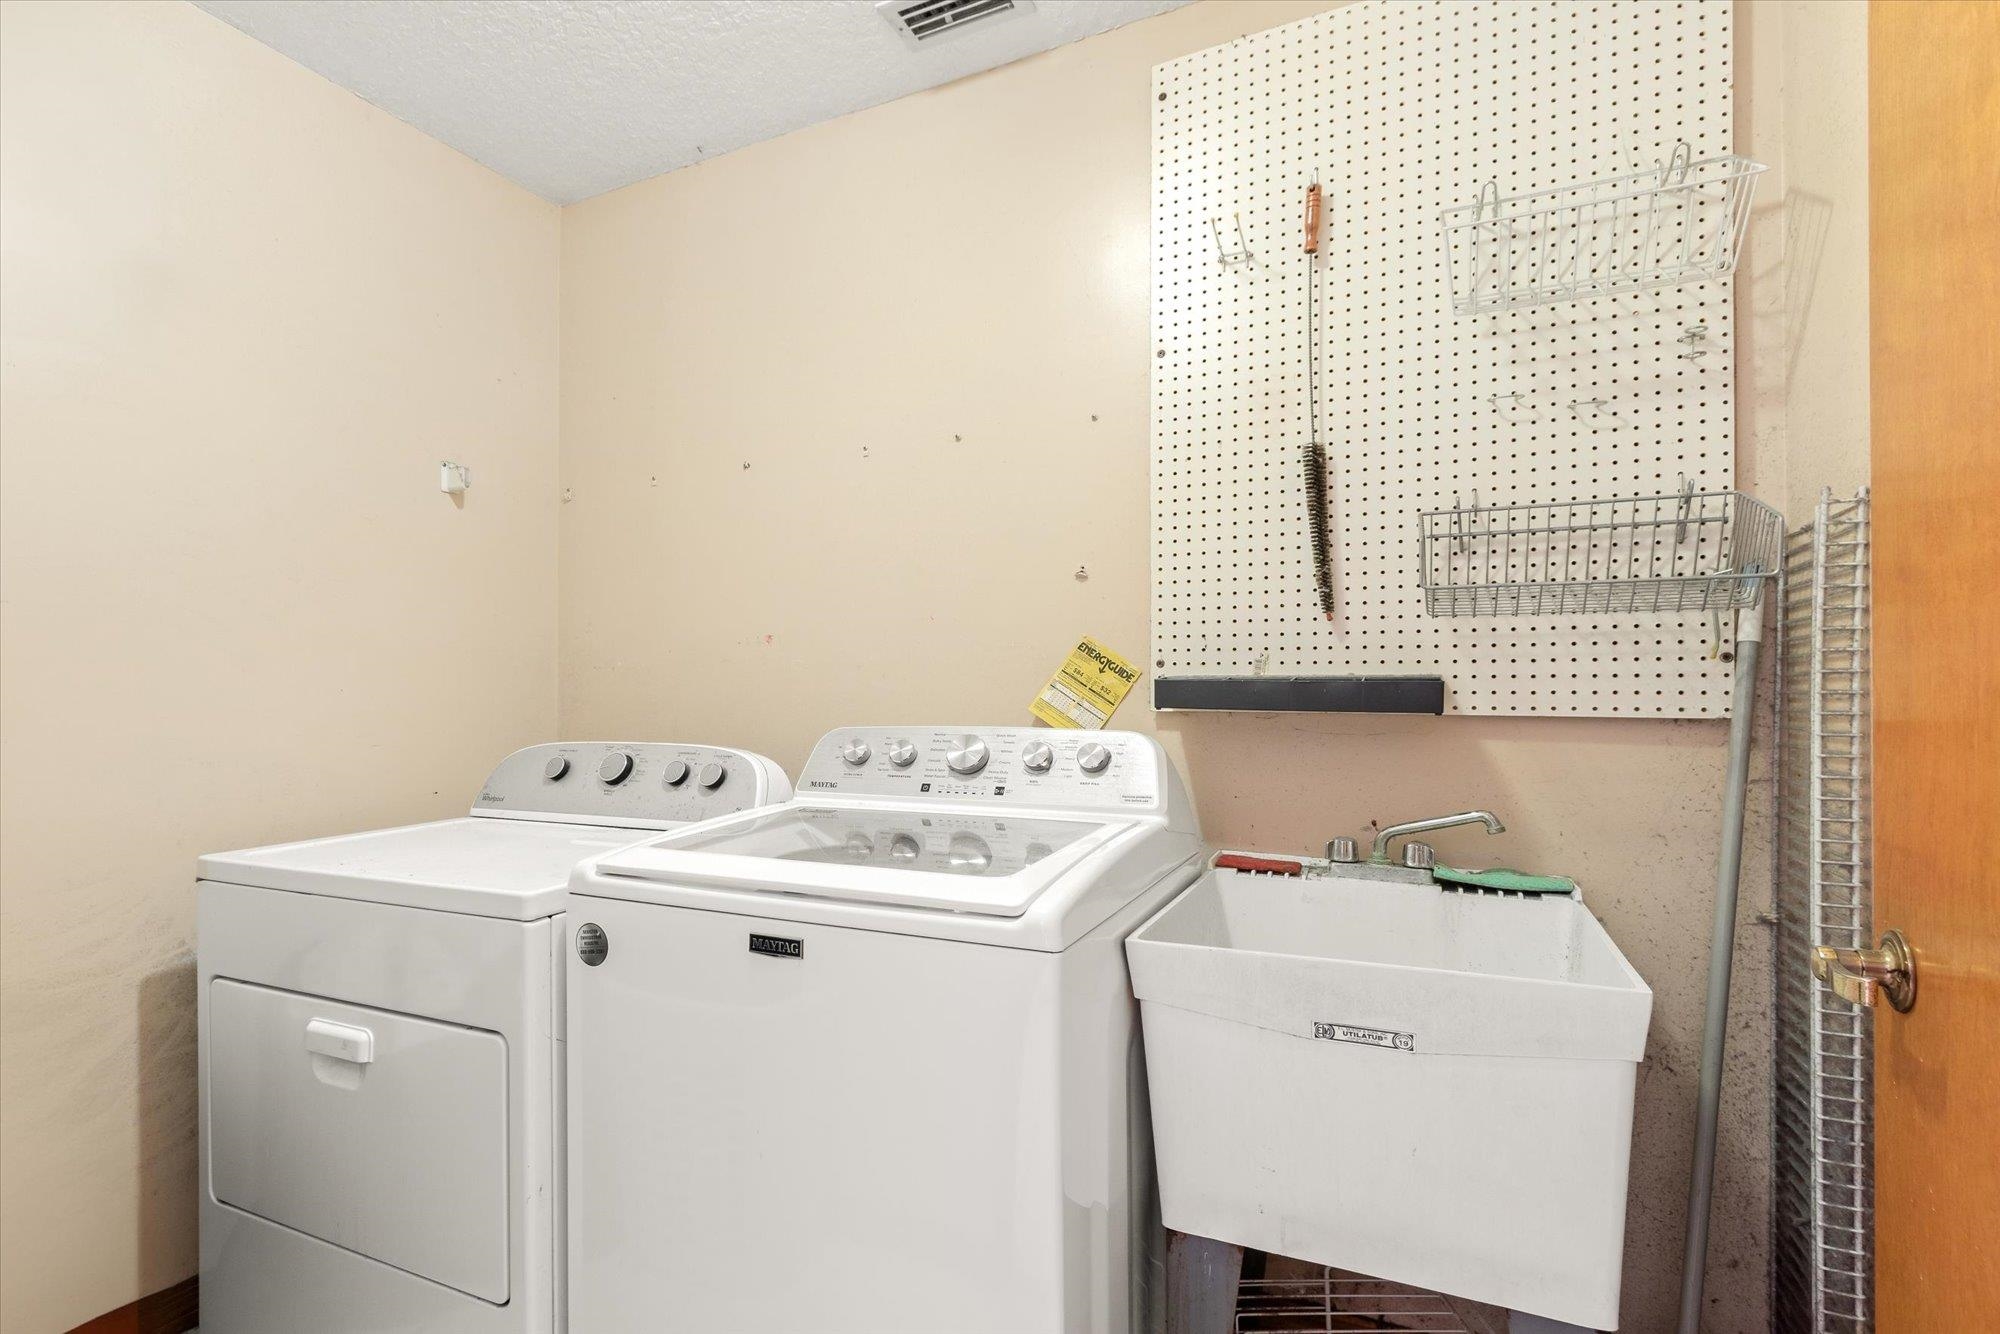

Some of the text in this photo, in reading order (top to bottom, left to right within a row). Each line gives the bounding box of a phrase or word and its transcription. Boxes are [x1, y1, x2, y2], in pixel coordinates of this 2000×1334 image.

[1077, 641, 1136, 683] ENERGYGUIDE
[482, 794, 505, 803] Whirlpool
[752, 937, 799, 954] MAYTAG
[1398, 1039, 1409, 1047] 19
